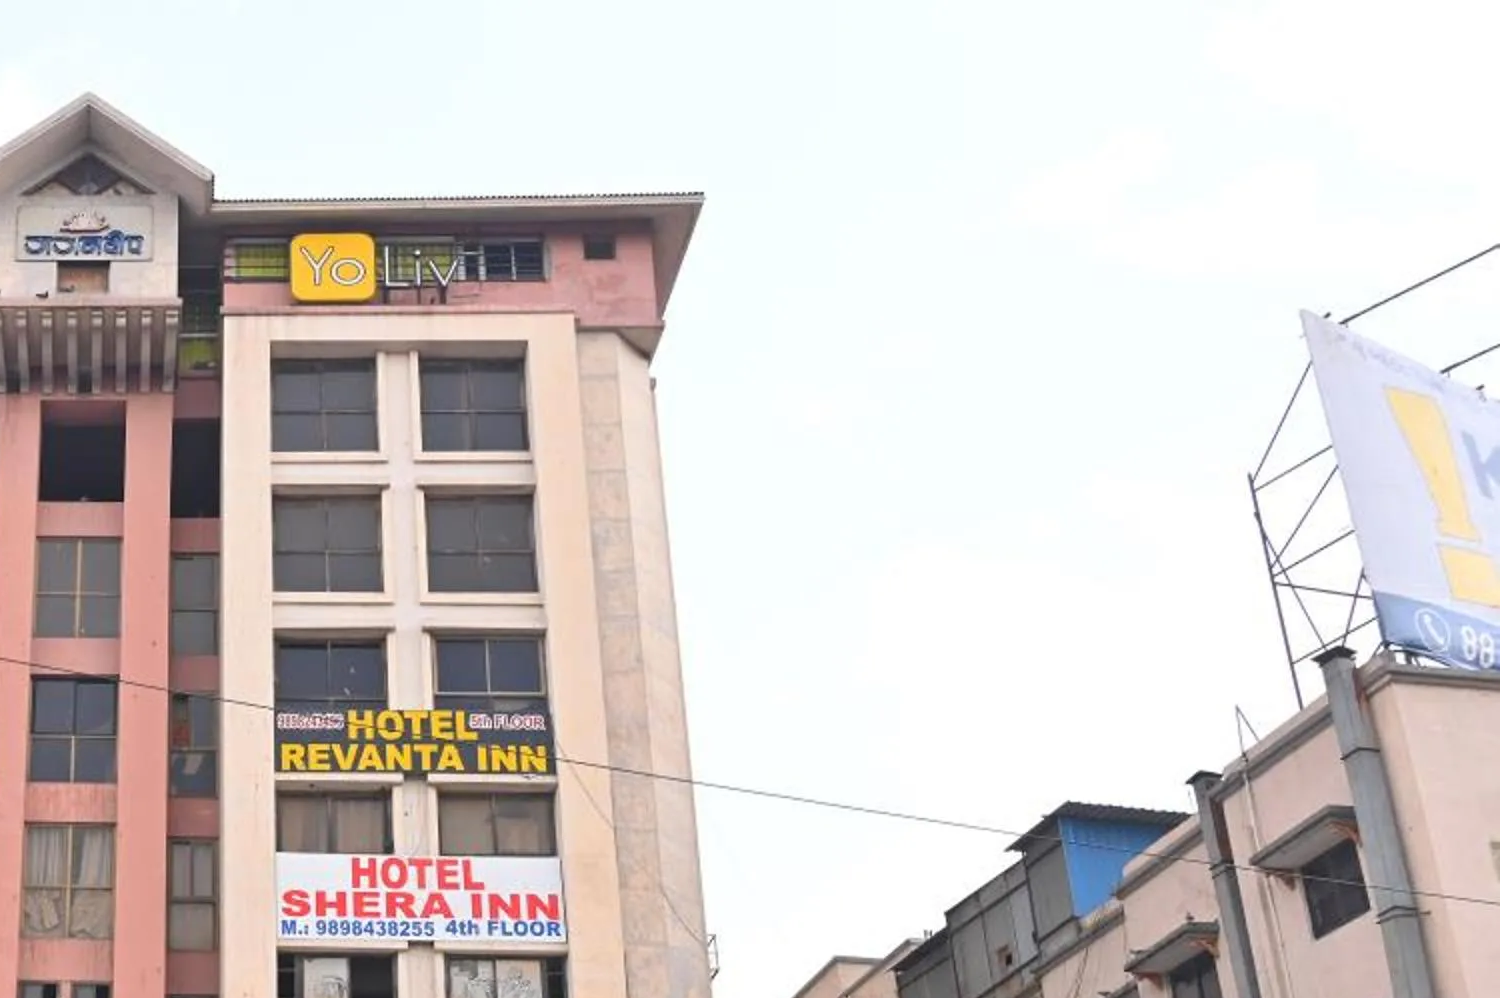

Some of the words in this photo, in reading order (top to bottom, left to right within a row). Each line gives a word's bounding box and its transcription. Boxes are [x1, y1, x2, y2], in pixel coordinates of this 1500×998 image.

[300, 245, 367, 286] Yo
[384, 245, 458, 288] Liv
[347, 709, 479, 741] HOTEL
[493, 715, 546, 731] FLOOR
[280, 743, 466, 771] REVANTA
[476, 745, 548, 772] INN
[351, 857, 486, 891] HOTEL
[281, 890, 455, 919] SHERA
[470, 893, 561, 920] INN
[315, 920, 436, 937] 9898438255
[444, 920, 480, 937] 4th
[487, 920, 561, 937] FLOOR
